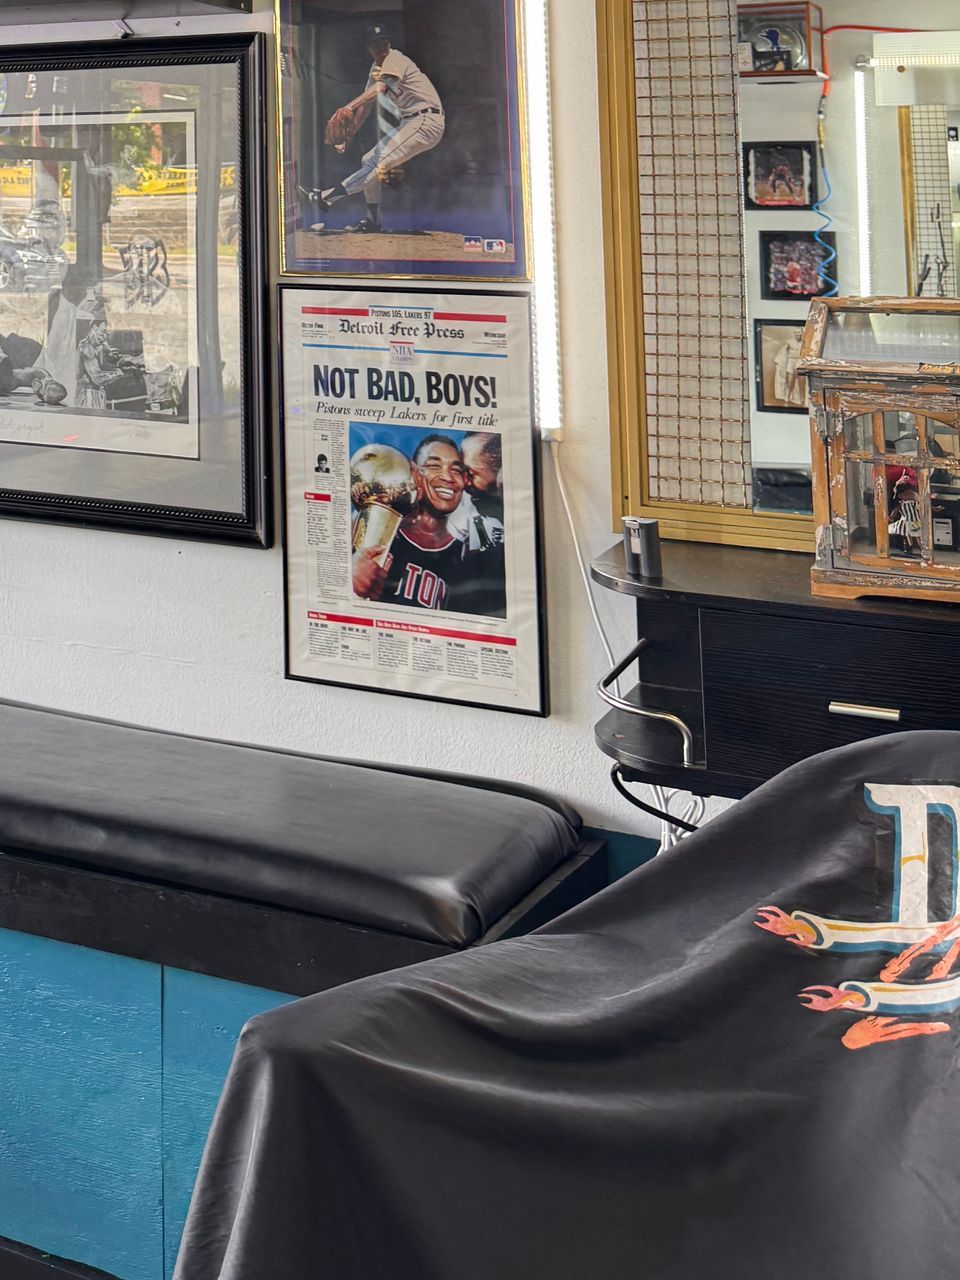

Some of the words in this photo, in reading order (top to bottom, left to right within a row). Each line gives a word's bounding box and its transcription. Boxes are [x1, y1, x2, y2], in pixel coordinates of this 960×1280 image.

[371, 309, 391, 318] PISTONS
[404, 311, 423, 320] LAKERS
[424, 312, 432, 320] 97
[339, 319, 384, 335] Detroit
[389, 321, 420, 336] Free
[423, 323, 465, 339] Press
[392, 345, 413, 356] NBA
[313, 364, 359, 399] NOT
[367, 368, 421, 406] BAD,
[425, 371, 498, 408] BOYS!
[316, 401, 351, 416] Pistons
[354, 406, 385, 419] sweep
[391, 406, 427, 421] Lakers
[429, 409, 448, 427] for
[448, 411, 474, 428] first
[477, 413, 498, 427] title
[394, 562, 447, 610] TON
